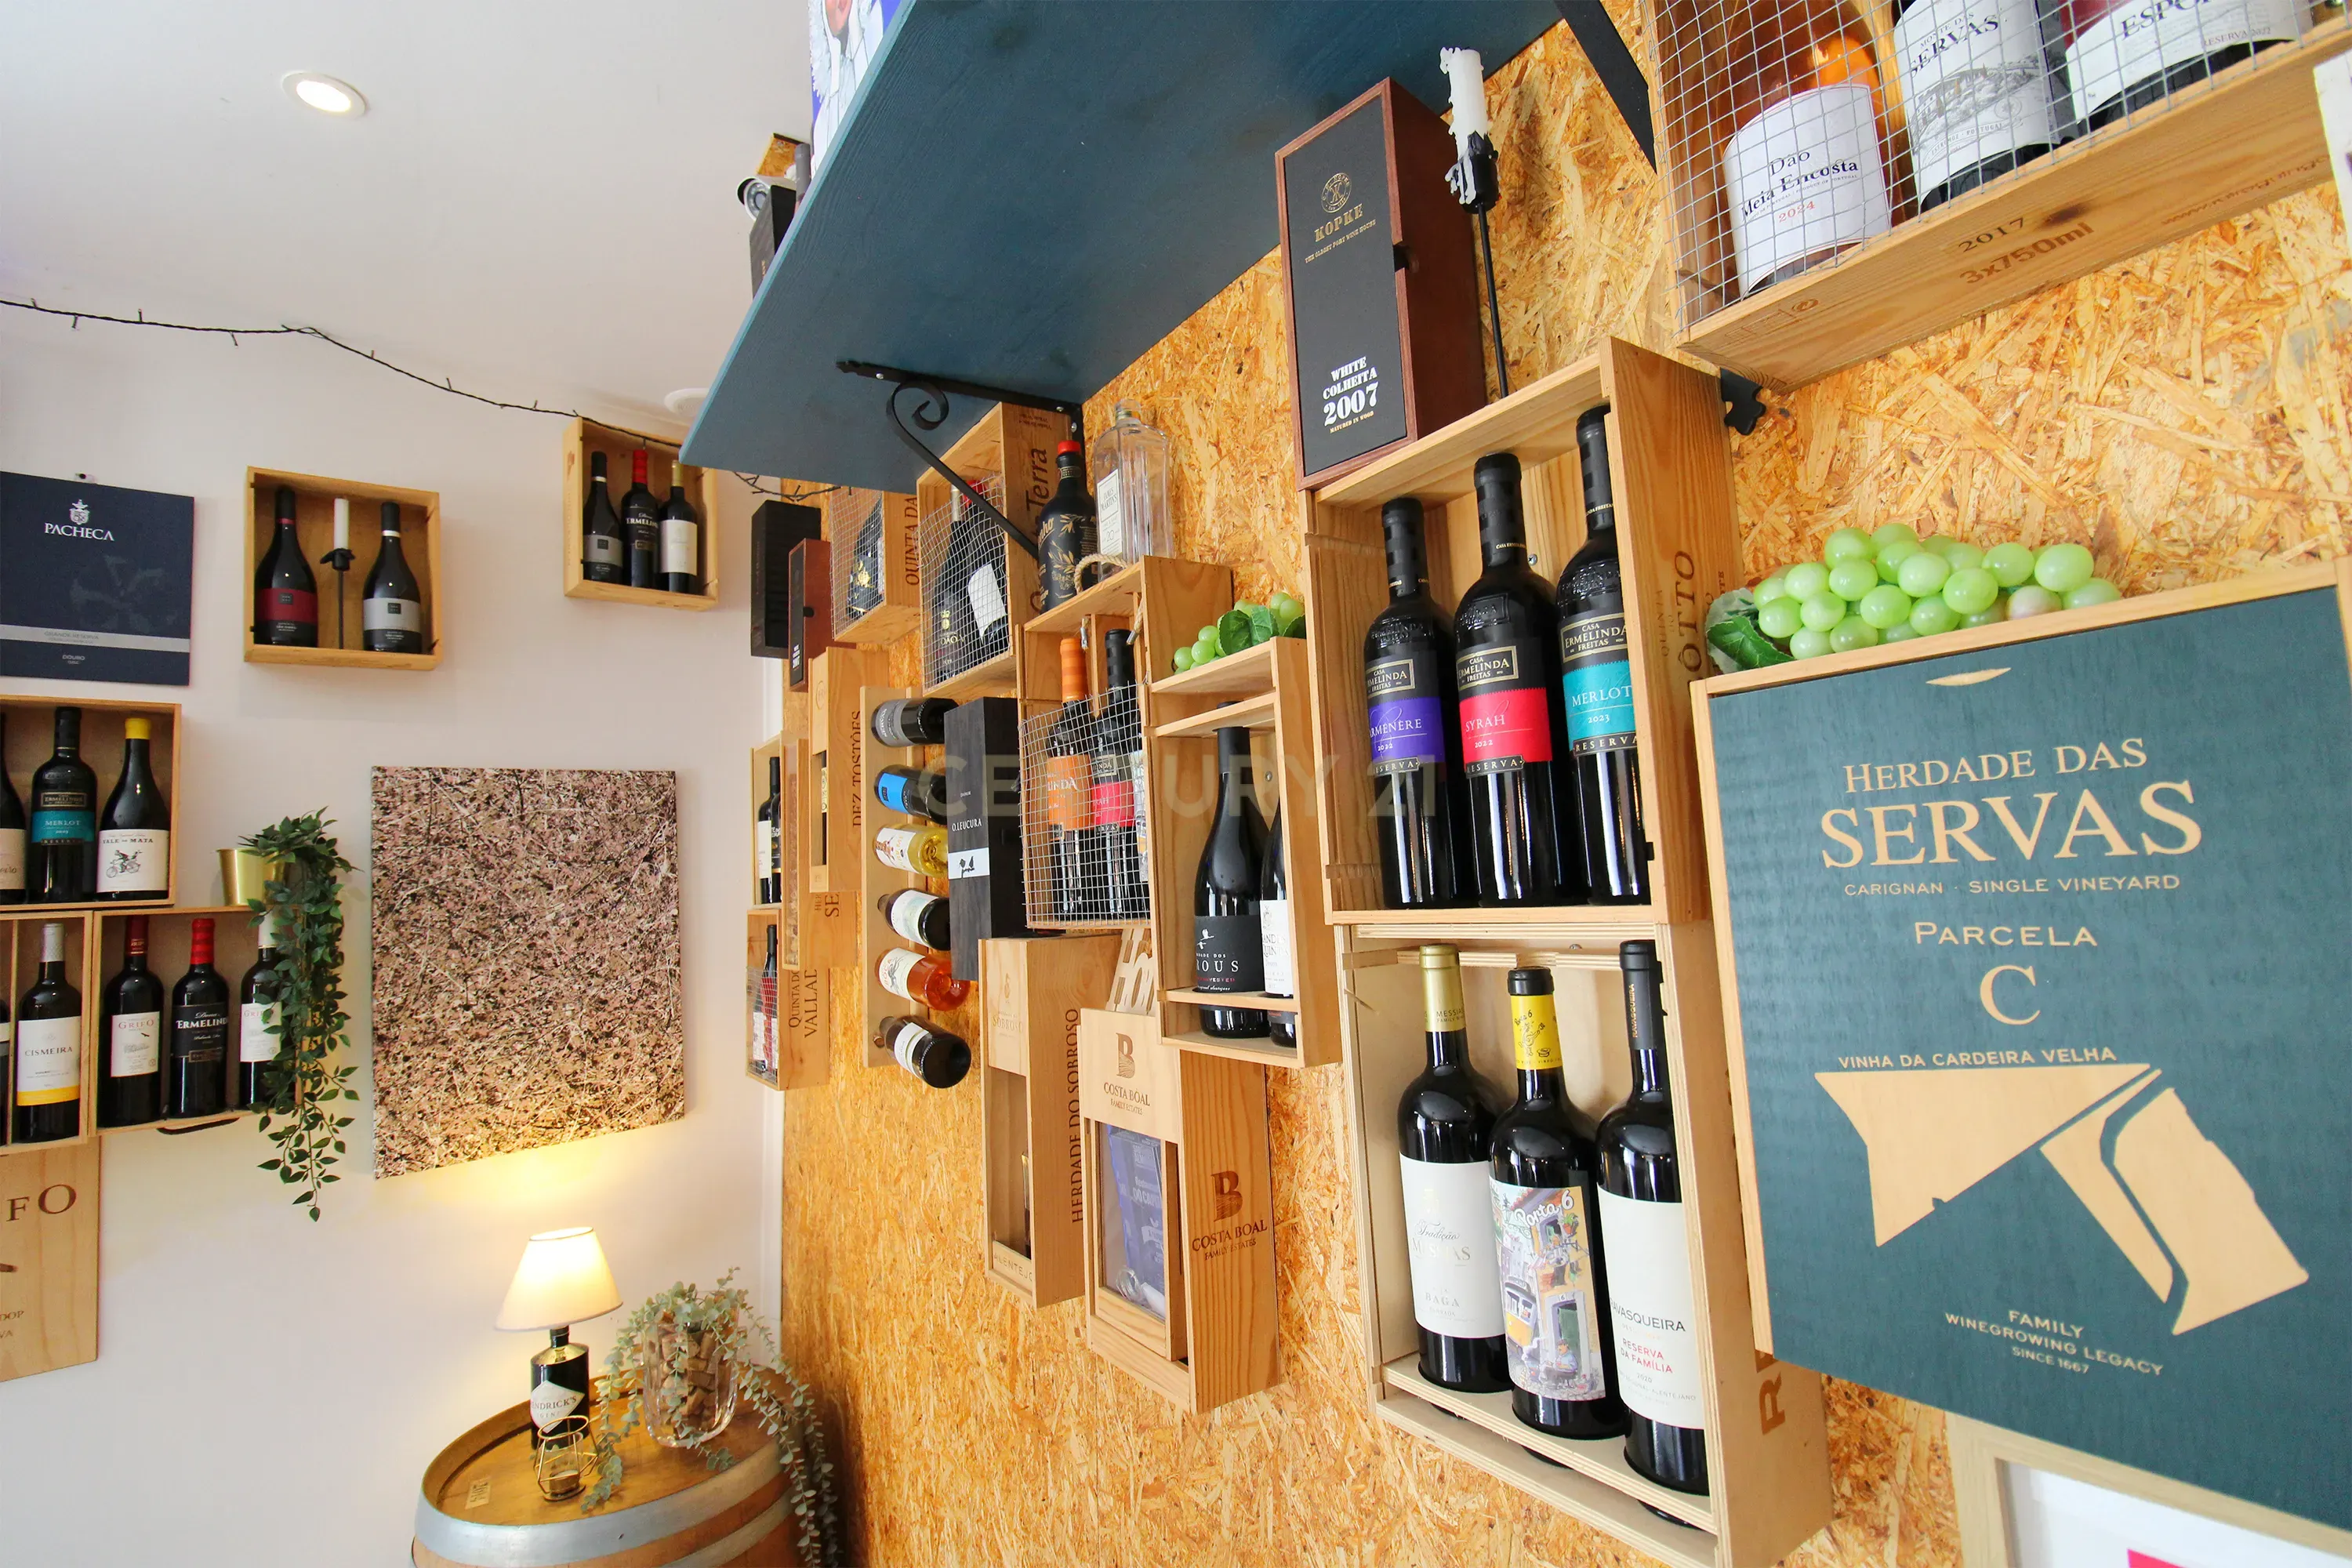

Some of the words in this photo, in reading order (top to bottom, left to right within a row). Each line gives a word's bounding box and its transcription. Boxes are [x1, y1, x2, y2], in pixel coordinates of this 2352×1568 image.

[1770, 151, 1810, 176] Dão
[1780, 162, 1858, 193] Encosta
[1314, 203, 1363, 242] KOPKE
[1779, 201, 1815, 223] 2024
[1958, 217, 2026, 252] 2017
[1959, 222, 2094, 285] 3x750ml
[1330, 356, 1367, 382] WHITE
[1323, 367, 1377, 400] COLHEITA
[1323, 381, 1378, 426] 2007
[1330, 420, 1352, 434] MATURED
[1360, 411, 1374, 421] WOOD
[1025, 448, 1049, 511] Terra
[904, 496, 918, 518] DA
[45, 522, 114, 541] PACHECA
[905, 524, 919, 586] QUINTA
[1565, 625, 1627, 649] ERMELINDA
[1582, 622, 1599, 633] CASA
[1577, 639, 1609, 652] FREITAS
[1458, 659, 1509, 679] ERMELINDA
[1467, 670, 1491, 682] FREITAS
[1371, 681, 1392, 692] FREITAS
[1572, 685, 1632, 707] MERLOT
[1465, 714, 1505, 732] SYRAH
[1588, 713, 1610, 723] 2023
[1377, 743, 1393, 752] 2022
[1475, 739, 1493, 749] 2022
[1842, 750, 2036, 793] HERDADE
[2053, 738, 2148, 775] DAS
[1820, 779, 2202, 869] SERVAS
[1844, 882, 1944, 896] CARIGNAN
[1969, 879, 2049, 893] SINGLE
[2057, 875, 2181, 891] VINEYARD
[1914, 921, 2097, 947] PARCELA
[789, 985, 802, 1028] QUINTA
[1980, 964, 2042, 1025] C
[118, 1019, 154, 1029] GRIFO
[1528, 1009, 1533, 1018] 6
[25, 1048, 73, 1057] CISMEIRA
[1065, 1009, 1080, 1094] SOBROSO
[1838, 1054, 1894, 1069] VINHA
[1900, 1054, 1926, 1068] DA
[1932, 1049, 2035, 1066] CARDEIRA
[2041, 1047, 2117, 1063] VELHA
[1104, 1082, 1127, 1100] COSTA
[1130, 1090, 1150, 1106] BOAL
[1068, 1099, 1080, 1127] DO
[1126, 1104, 1142, 1115] ESTATES
[1069, 1134, 1083, 1223] HERDADE
[1514, 1203, 1560, 1226] Porta
[1561, 1190, 1574, 1210] 6
[1192, 1229, 1232, 1252] COSTA
[1235, 1219, 1268, 1242] BOAL
[1414, 1219, 1461, 1240] Tradição
[1204, 1247, 1229, 1261] FAMILY
[1229, 1238, 1257, 1254] ESTATES
[1425, 1292, 1460, 1308] BAGA
[2008, 1310, 2084, 1339] FAMILY
[1623, 1338, 1664, 1360] RESERVA
[1945, 1312, 2077, 1355] WINEGROWING
[2084, 1346, 2164, 1376] LEGACY
[1621, 1347, 1629, 1360] DA
[1632, 1354, 1673, 1374] FAMÍLIA
[2013, 1346, 2055, 1366] SINCE
[2057, 1359, 2090, 1374] 1667
[1637, 1373, 1653, 1383] 2020
